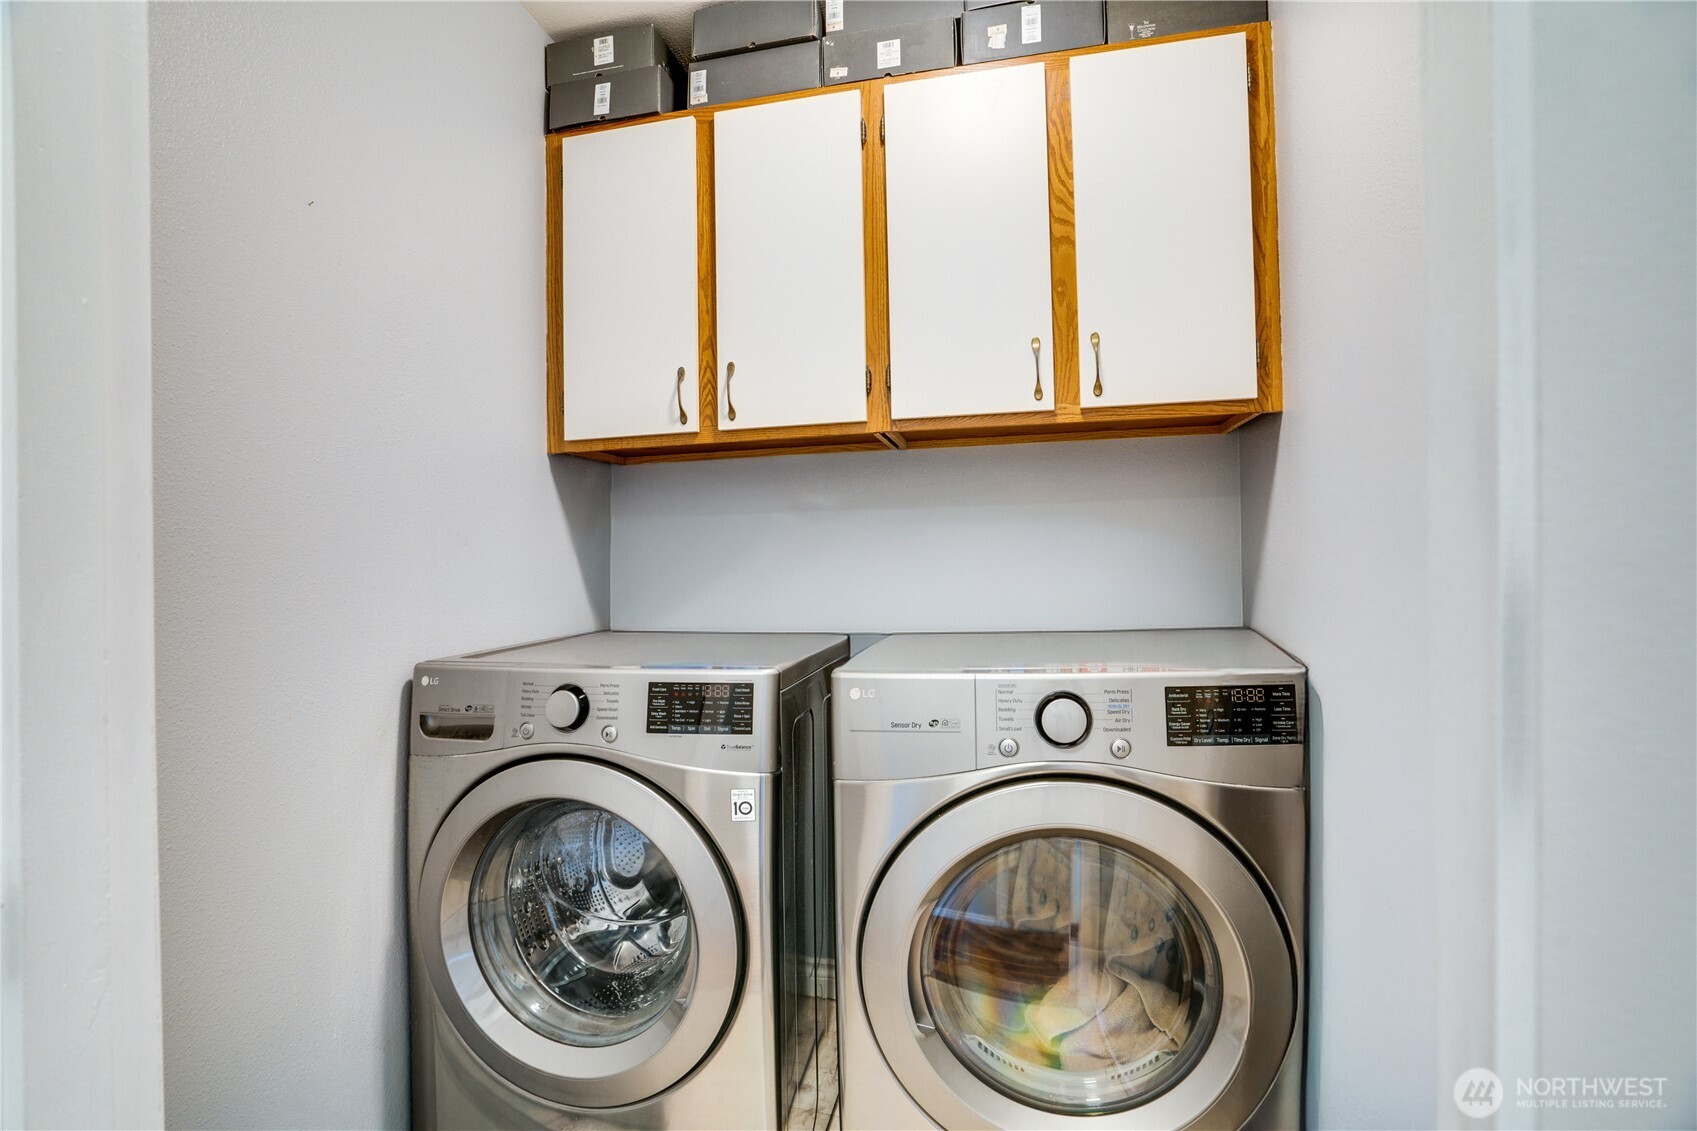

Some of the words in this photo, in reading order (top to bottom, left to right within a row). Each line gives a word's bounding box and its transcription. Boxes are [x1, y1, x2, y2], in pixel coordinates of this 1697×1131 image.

[430, 677, 439, 685] LG
[862, 689, 876, 698] LG
[912, 722, 922, 730] Dry
[734, 801, 752, 815] 10
